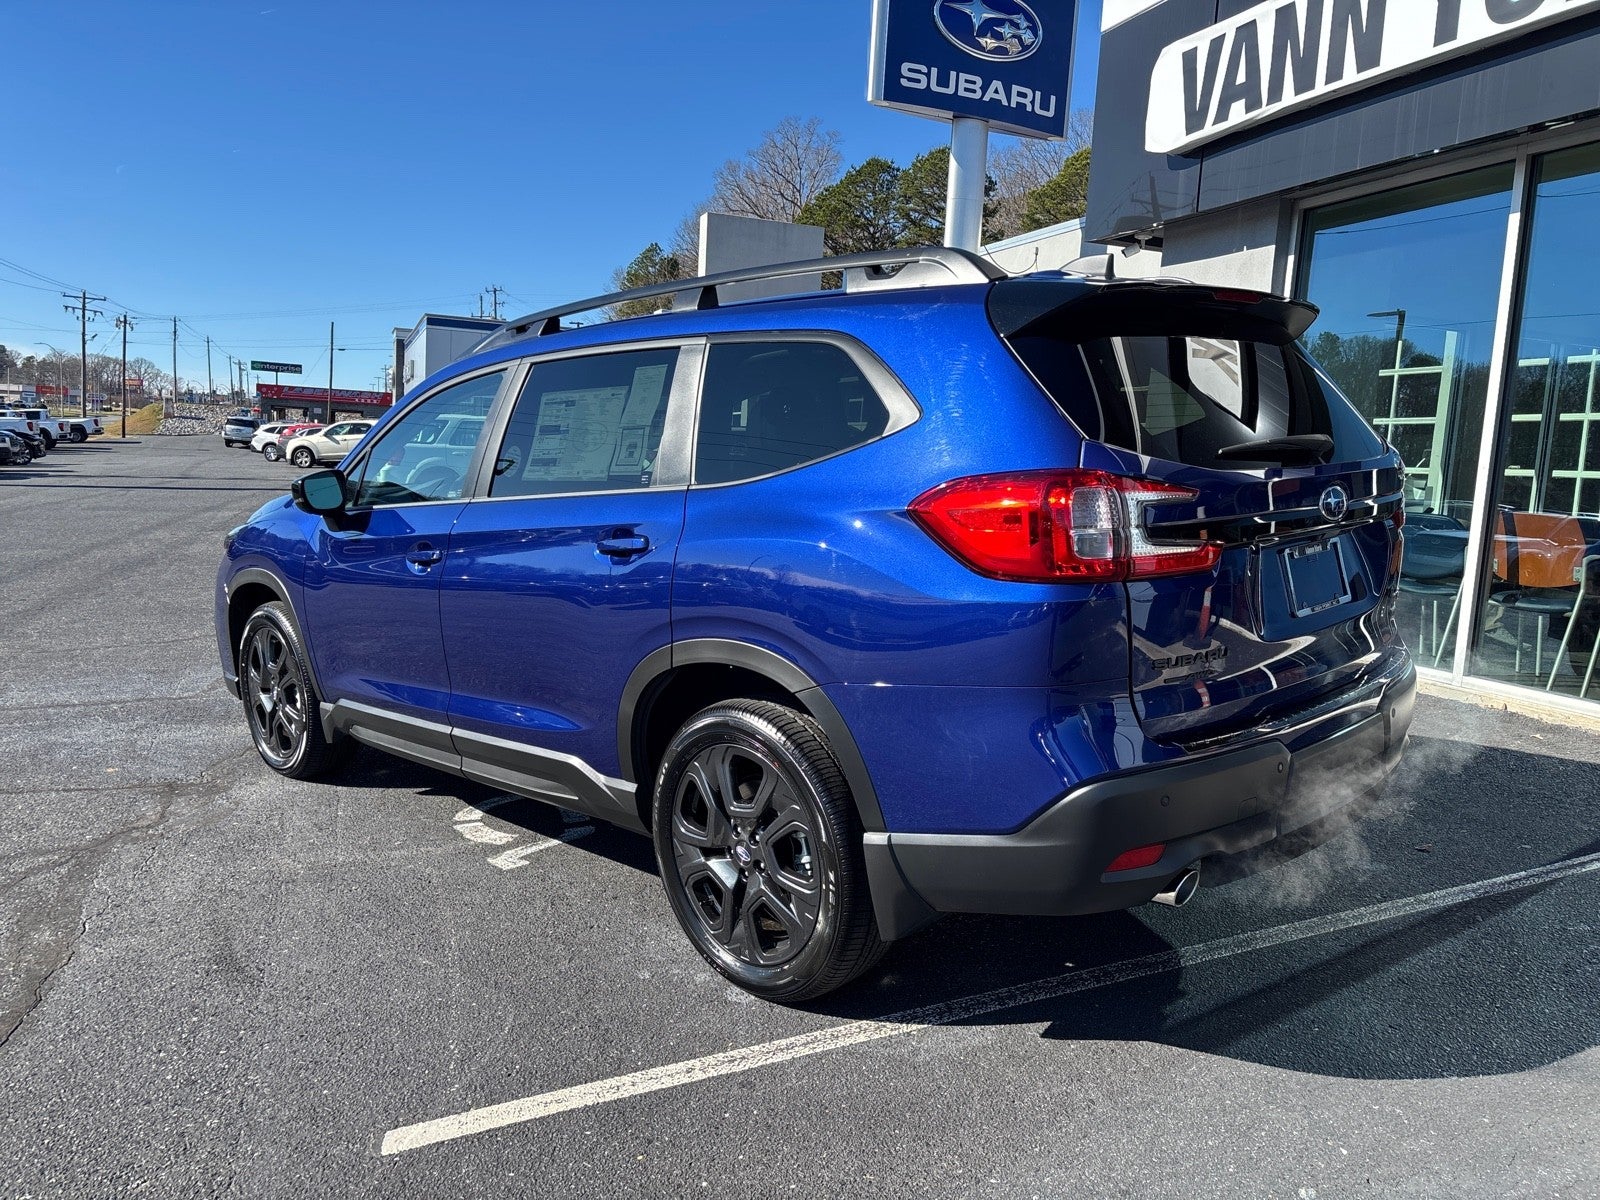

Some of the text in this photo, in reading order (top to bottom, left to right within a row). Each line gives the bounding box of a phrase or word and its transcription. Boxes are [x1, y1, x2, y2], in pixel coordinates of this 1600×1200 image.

[1182, 0, 1387, 136] VANN
[900, 62, 1056, 118] SUBARU
[254, 363, 301, 372] enterprise
[1151, 646, 1229, 670] SUBARU
